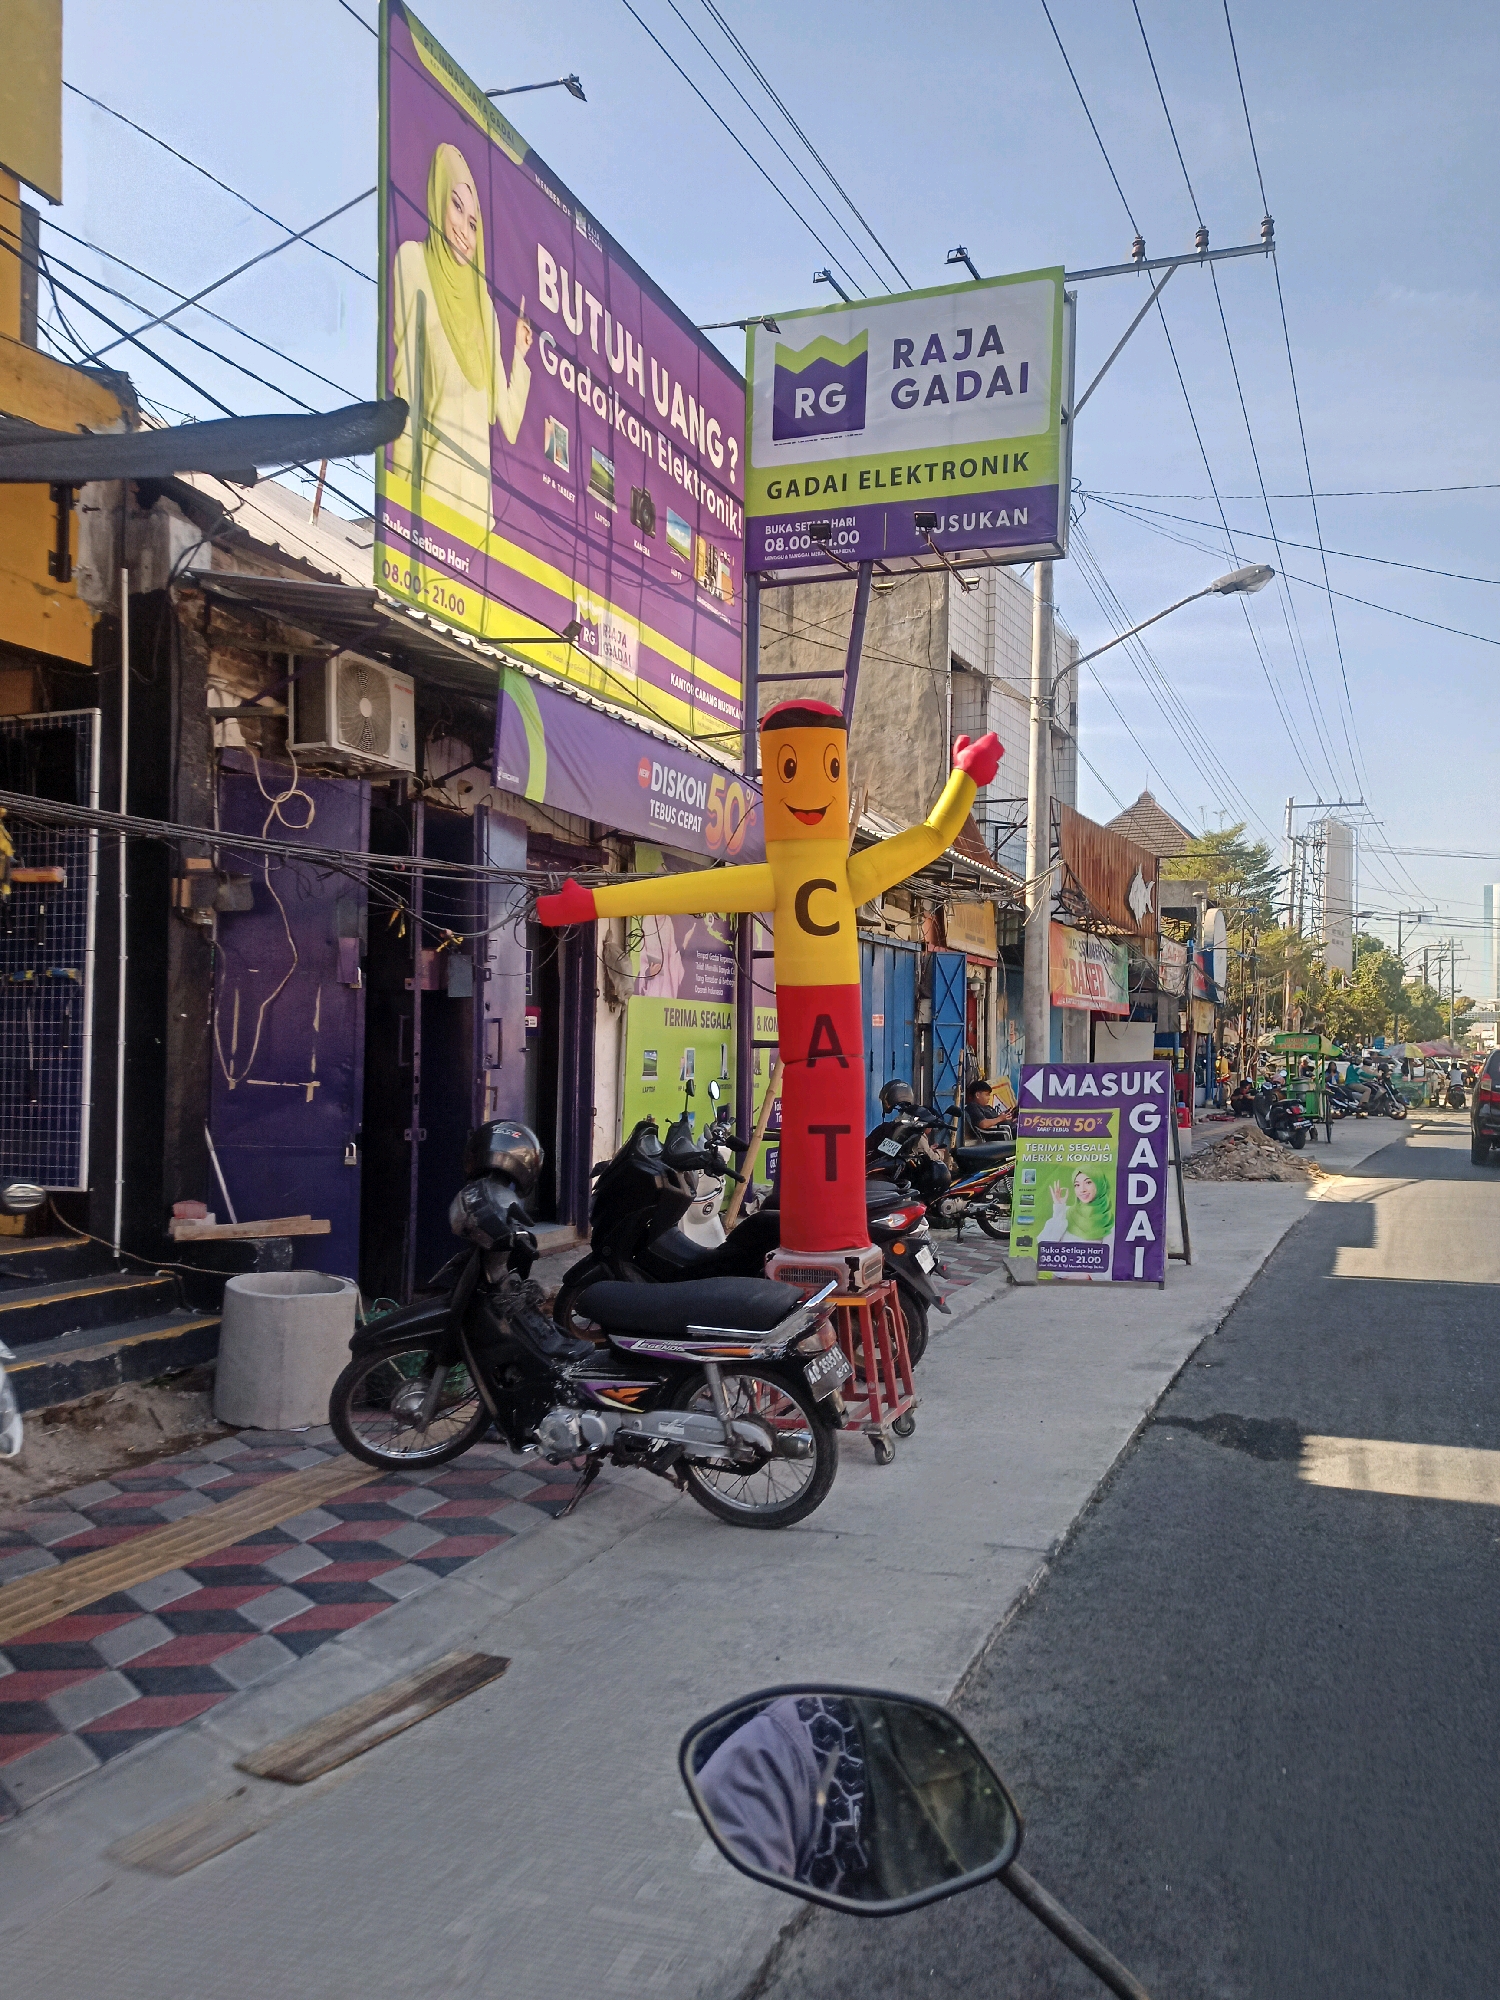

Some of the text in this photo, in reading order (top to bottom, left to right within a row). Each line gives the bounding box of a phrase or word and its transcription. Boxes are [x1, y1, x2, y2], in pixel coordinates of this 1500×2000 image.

[438, 53, 465, 89] INDAH
[468, 86, 488, 115] JAYA
[489, 111, 515, 145] GADAI
[535, 174, 560, 207] MEMBER
[537, 242, 645, 398] BUTUH
[893, 324, 1005, 370] RAJA
[794, 382, 847, 419] RG
[891, 361, 1029, 410] GADAI
[538, 331, 744, 540] Gadaikan Elektronik!
[766, 451, 1029, 500] GADAI ELEKTRONIK
[765, 523, 793, 535] BUKA
[831, 516, 856, 529] HARI
[412, 529, 446, 561] Setiap
[447, 548, 469, 573] Hari
[381, 559, 422, 594] 08.00
[432, 585, 465, 616] 21.00
[583, 626, 596, 646] RG
[670, 672, 694, 696] KANTOR
[695, 687, 718, 708] CABANG
[639, 768, 650, 779] NEW
[650, 799, 703, 833] TEBUS CEPAT
[651, 761, 757, 856] DISKON 50%
[664, 1007, 698, 1029] TERIMA
[700, 1008, 732, 1030] SEGALA
[1048, 1070, 1165, 1098] MASUK
[1073, 1117, 1103, 1133] 50%
[1022, 1153, 1113, 1162] MERK & KONDISI
[1025, 1143, 1111, 1152] TERIMA SEGALA
[1040, 1246, 1104, 1256] Buka Setiap Hari
[1040, 1254, 1067, 1263] 08.00
[1075, 1255, 1102, 1264] 21.00
